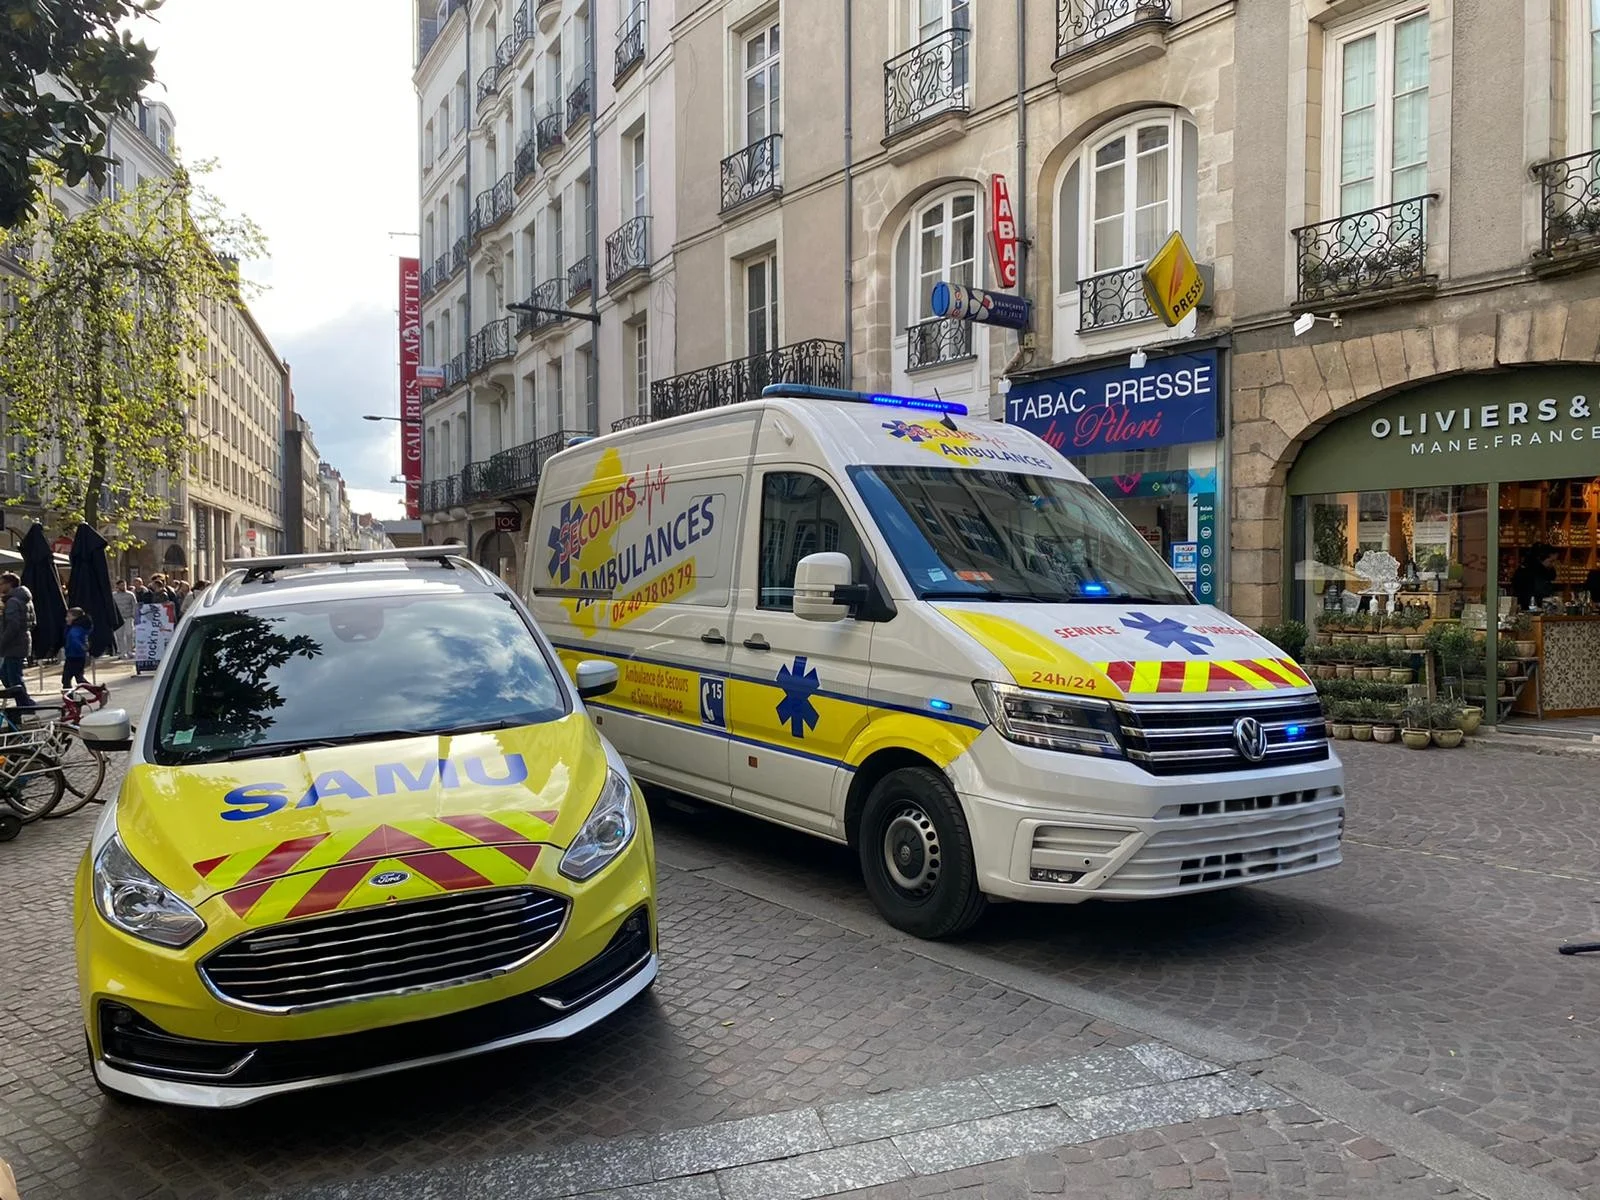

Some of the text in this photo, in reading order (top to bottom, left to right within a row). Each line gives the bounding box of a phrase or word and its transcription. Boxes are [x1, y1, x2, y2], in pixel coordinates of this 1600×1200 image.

[995, 177, 1016, 282] TABAC
[1010, 366, 1211, 422] TABAC PRESSE
[1371, 395, 1591, 438] OLIVIERS &
[1040, 401, 1163, 450] du Pilori
[940, 443, 1053, 470] AMBULANCES
[496, 517, 516, 527] TOC
[560, 477, 637, 563] SECOURS
[576, 496, 714, 613] AMBULANCES
[612, 563, 692, 622] 02 40 78 03 79
[1054, 625, 1120, 639] SERVICE
[625, 664, 689, 692] Ambulance de Secours
[711, 683, 722, 699] 15
[1031, 670, 1097, 691] 24h/24
[220, 753, 528, 821] SAMU
